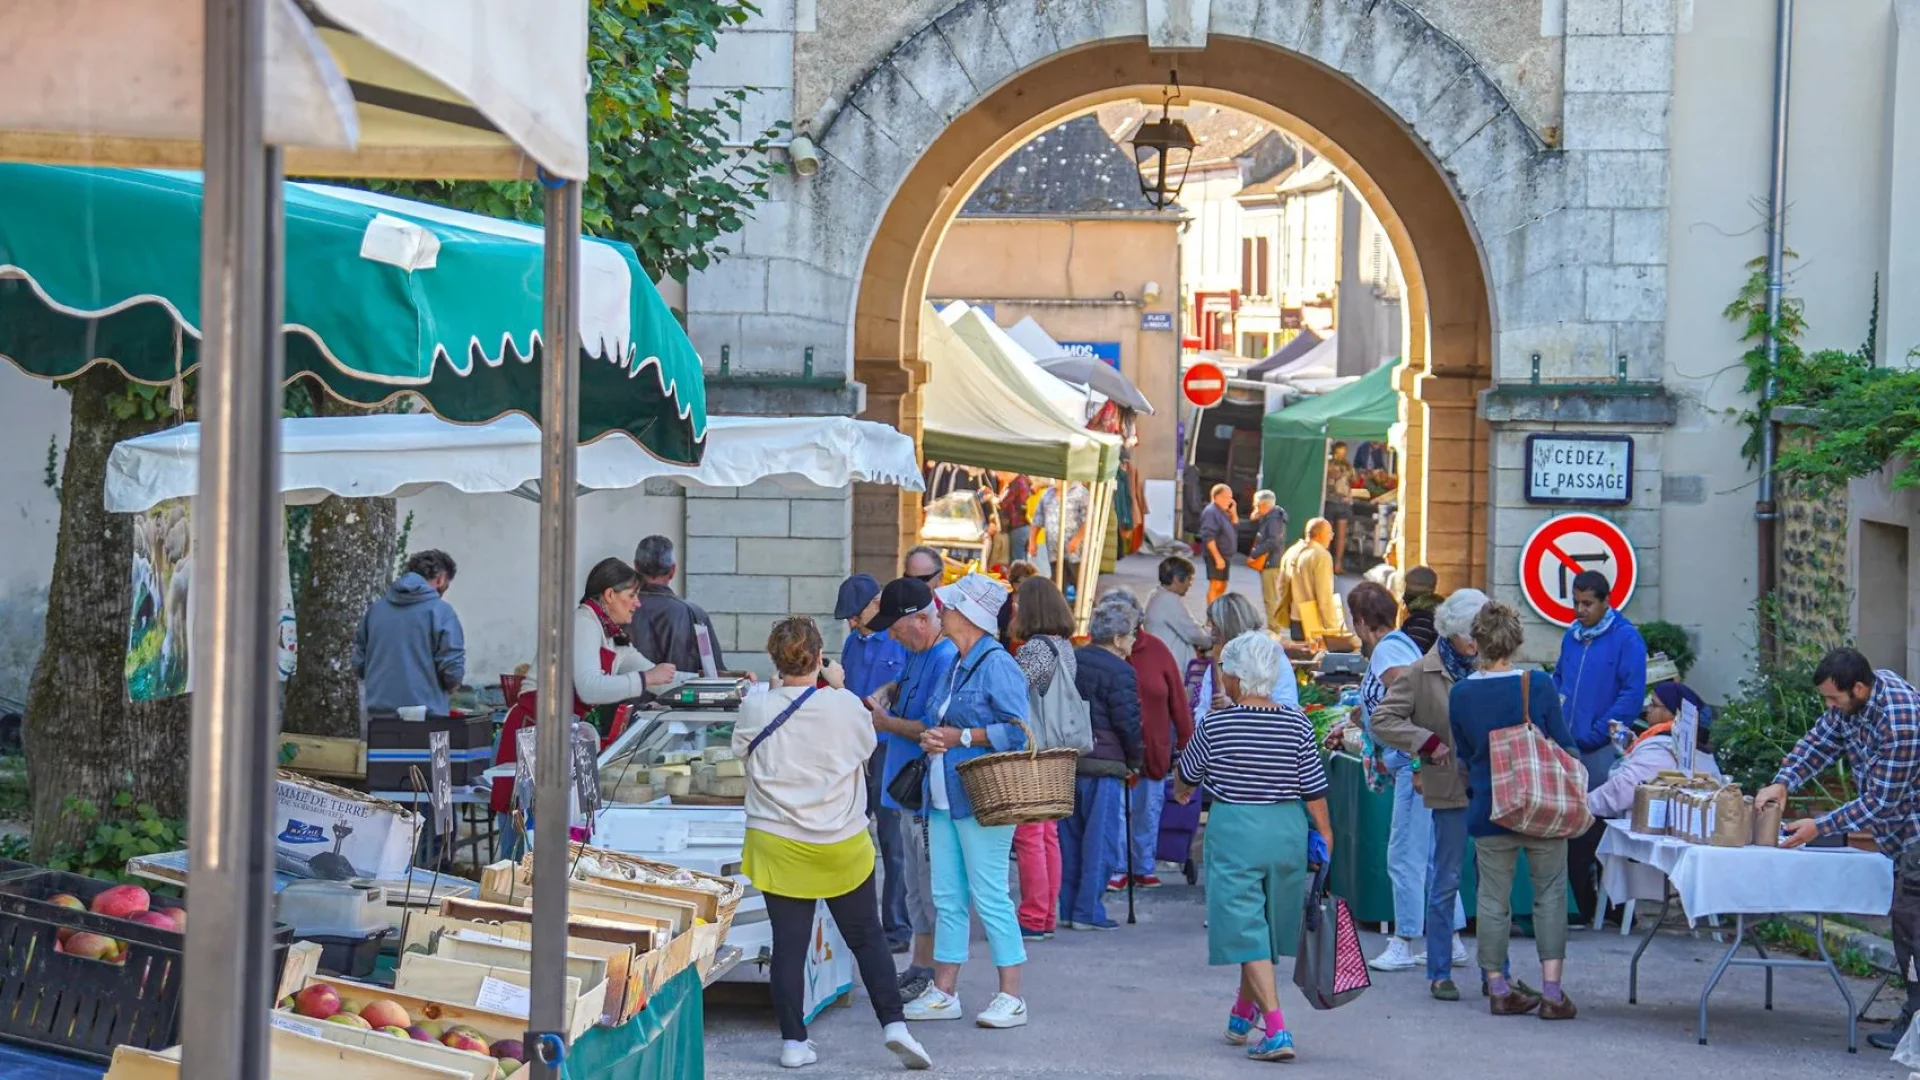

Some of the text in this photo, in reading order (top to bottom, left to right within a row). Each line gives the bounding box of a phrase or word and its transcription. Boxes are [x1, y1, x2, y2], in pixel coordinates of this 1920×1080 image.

[1057, 344, 1093, 357] MOS
[1555, 446, 1606, 466] CÉDEZ
[1534, 472, 1624, 489] LE PASSAGE
[310, 794, 327, 807] DE
[331, 799, 369, 819] TERRE
